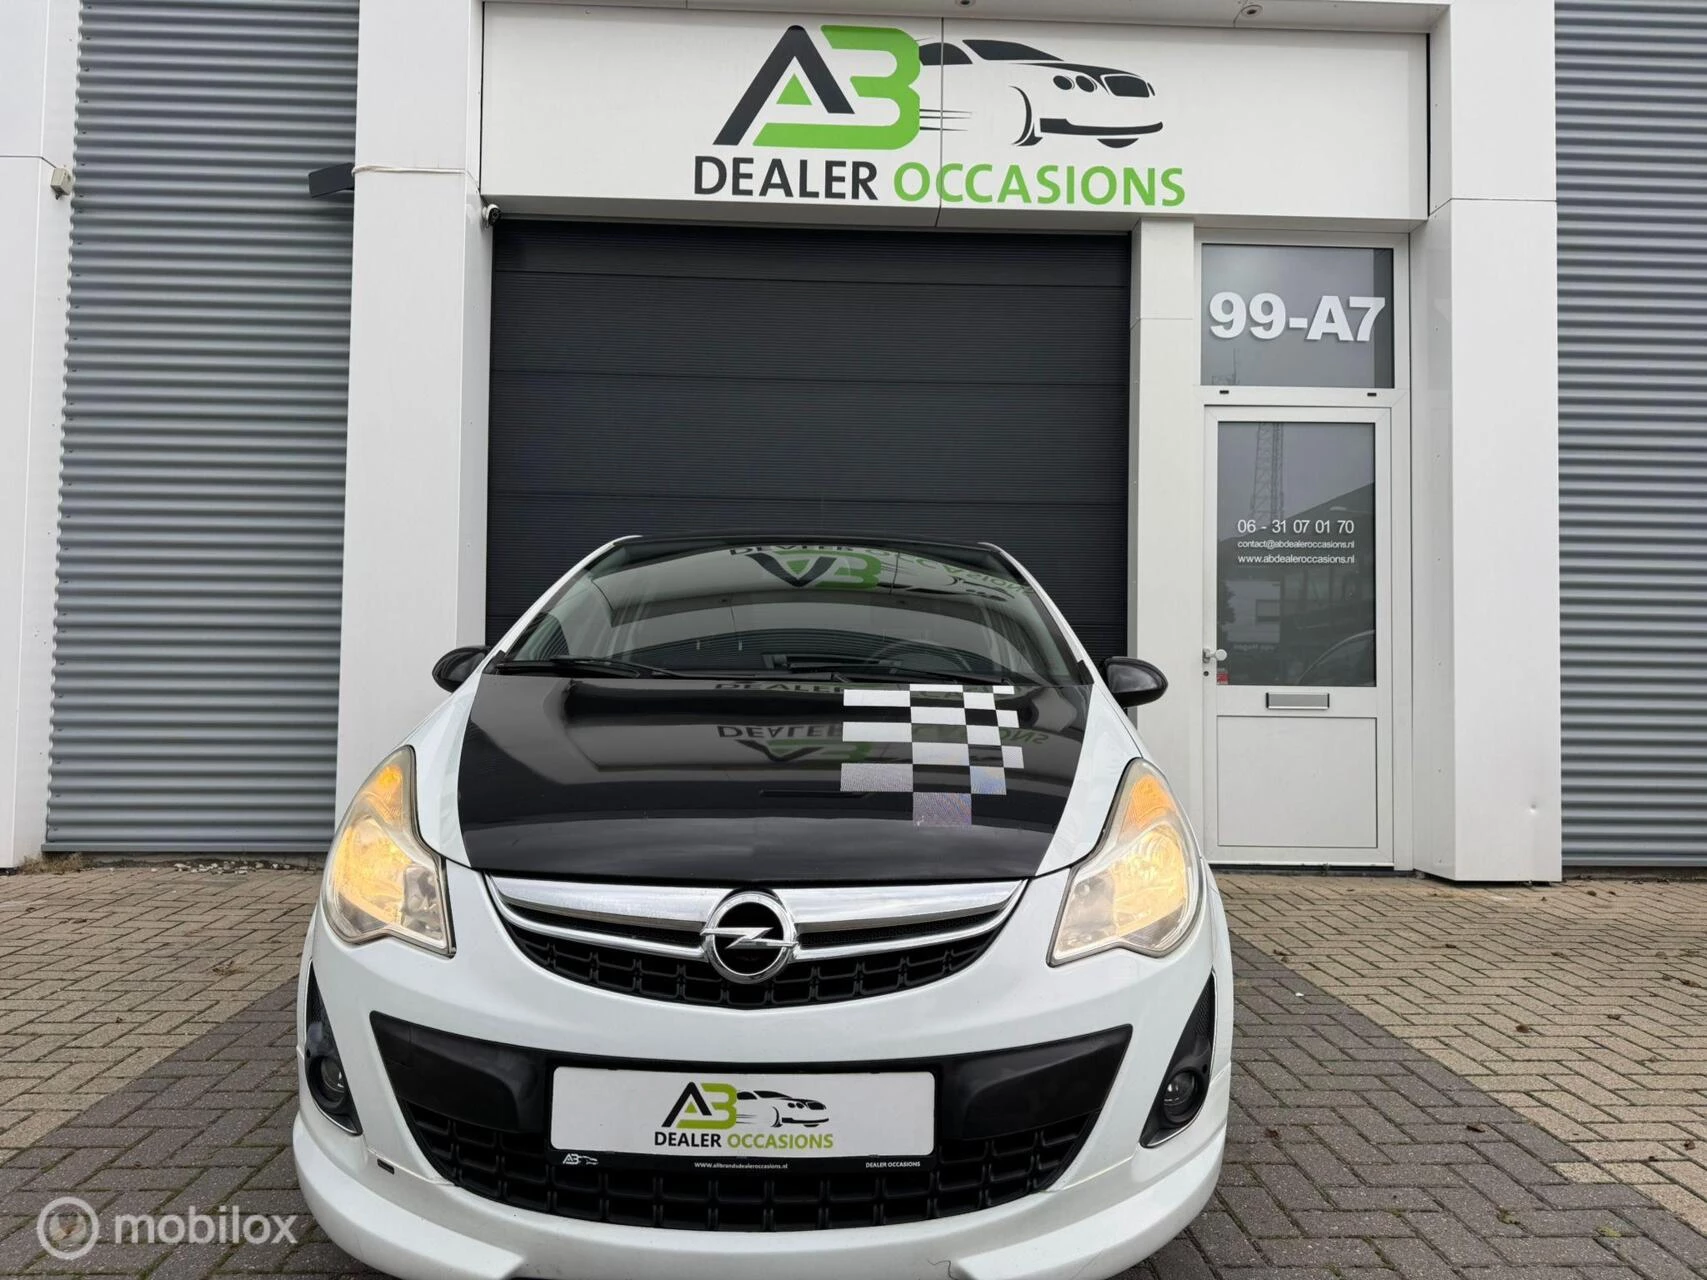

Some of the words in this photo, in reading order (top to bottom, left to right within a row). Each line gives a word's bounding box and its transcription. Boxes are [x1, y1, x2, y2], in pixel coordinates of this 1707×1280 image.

[694, 155, 878, 200] DEALER
[893, 161, 1186, 207] OCCASIONS
[1209, 291, 1386, 342] 99-A7
[1237, 519, 1257, 534] 06
[1271, 519, 1287, 534] 31
[1293, 519, 1310, 534] 07
[1315, 519, 1330, 534] 01
[1337, 520, 1355, 534] 70
[1237, 539, 1355, 550] contact@abdealeroccasions.nl
[1237, 554, 1355, 564] www.abdealeroccasions.nl
[654, 1131, 722, 1148] DEALER
[727, 1133, 834, 1149] OCCASIONS
